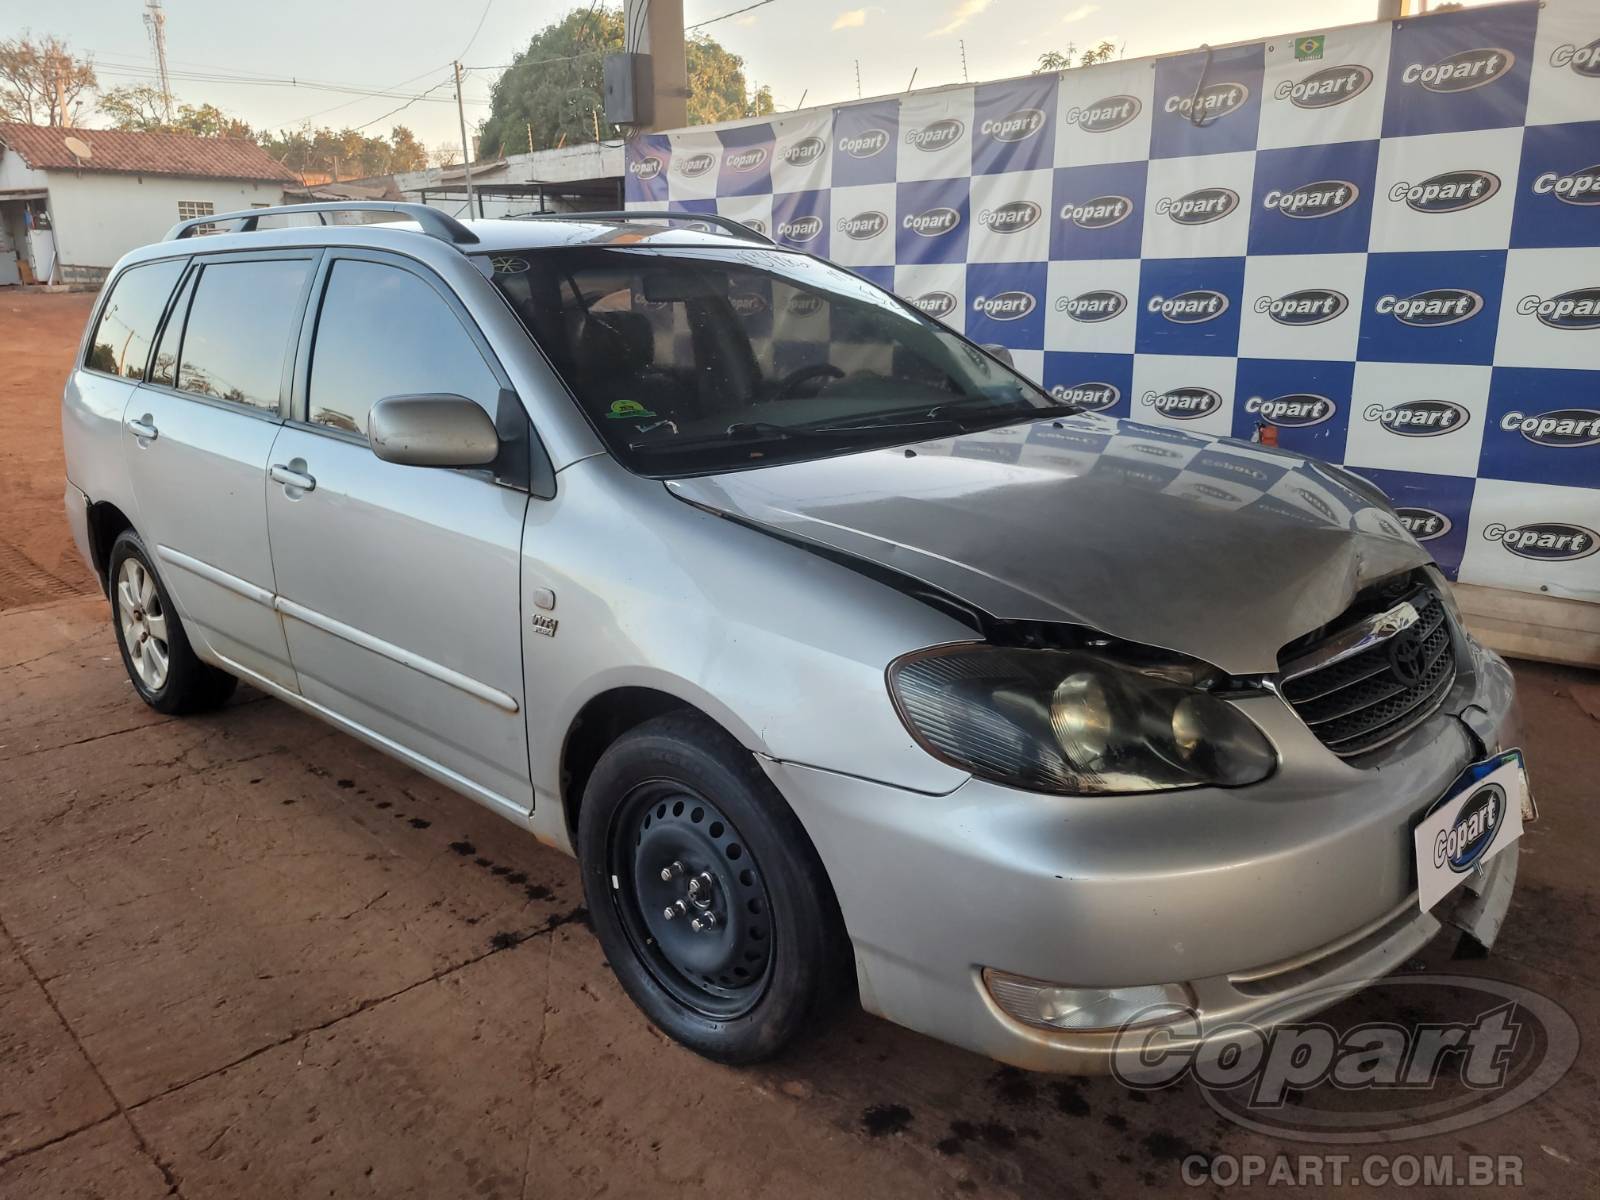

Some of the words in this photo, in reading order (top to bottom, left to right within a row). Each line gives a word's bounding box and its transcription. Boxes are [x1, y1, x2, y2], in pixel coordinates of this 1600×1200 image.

[1402, 53, 1498, 85] Copart
[1275, 73, 1357, 100] Copart
[1066, 100, 1132, 125] Copart
[906, 123, 955, 147] Copart
[981, 114, 1039, 136] Copart
[839, 134, 883, 155] Copart
[630, 159, 659, 175] Copart
[726, 151, 762, 168] Copart
[1263, 187, 1350, 212] Copart
[1388, 177, 1484, 203] Copart
[903, 211, 953, 230] Copart
[978, 206, 1033, 229] Copart
[1060, 202, 1125, 225] Copart
[1155, 197, 1229, 221] Copart
[777, 221, 819, 240] Copart
[837, 216, 881, 242] Copart
[973, 293, 1029, 316] Copart
[1055, 292, 1119, 317] Copart
[1148, 293, 1222, 318] Copart
[1254, 295, 1336, 319] Copart
[1375, 295, 1470, 320] Copart
[1051, 384, 1113, 406] Copart
[1142, 390, 1215, 413] Copart
[1245, 397, 1327, 418] Copart
[1363, 403, 1459, 427] Copart
[1483, 522, 1587, 551] Copart
[1433, 791, 1498, 869] Copart
